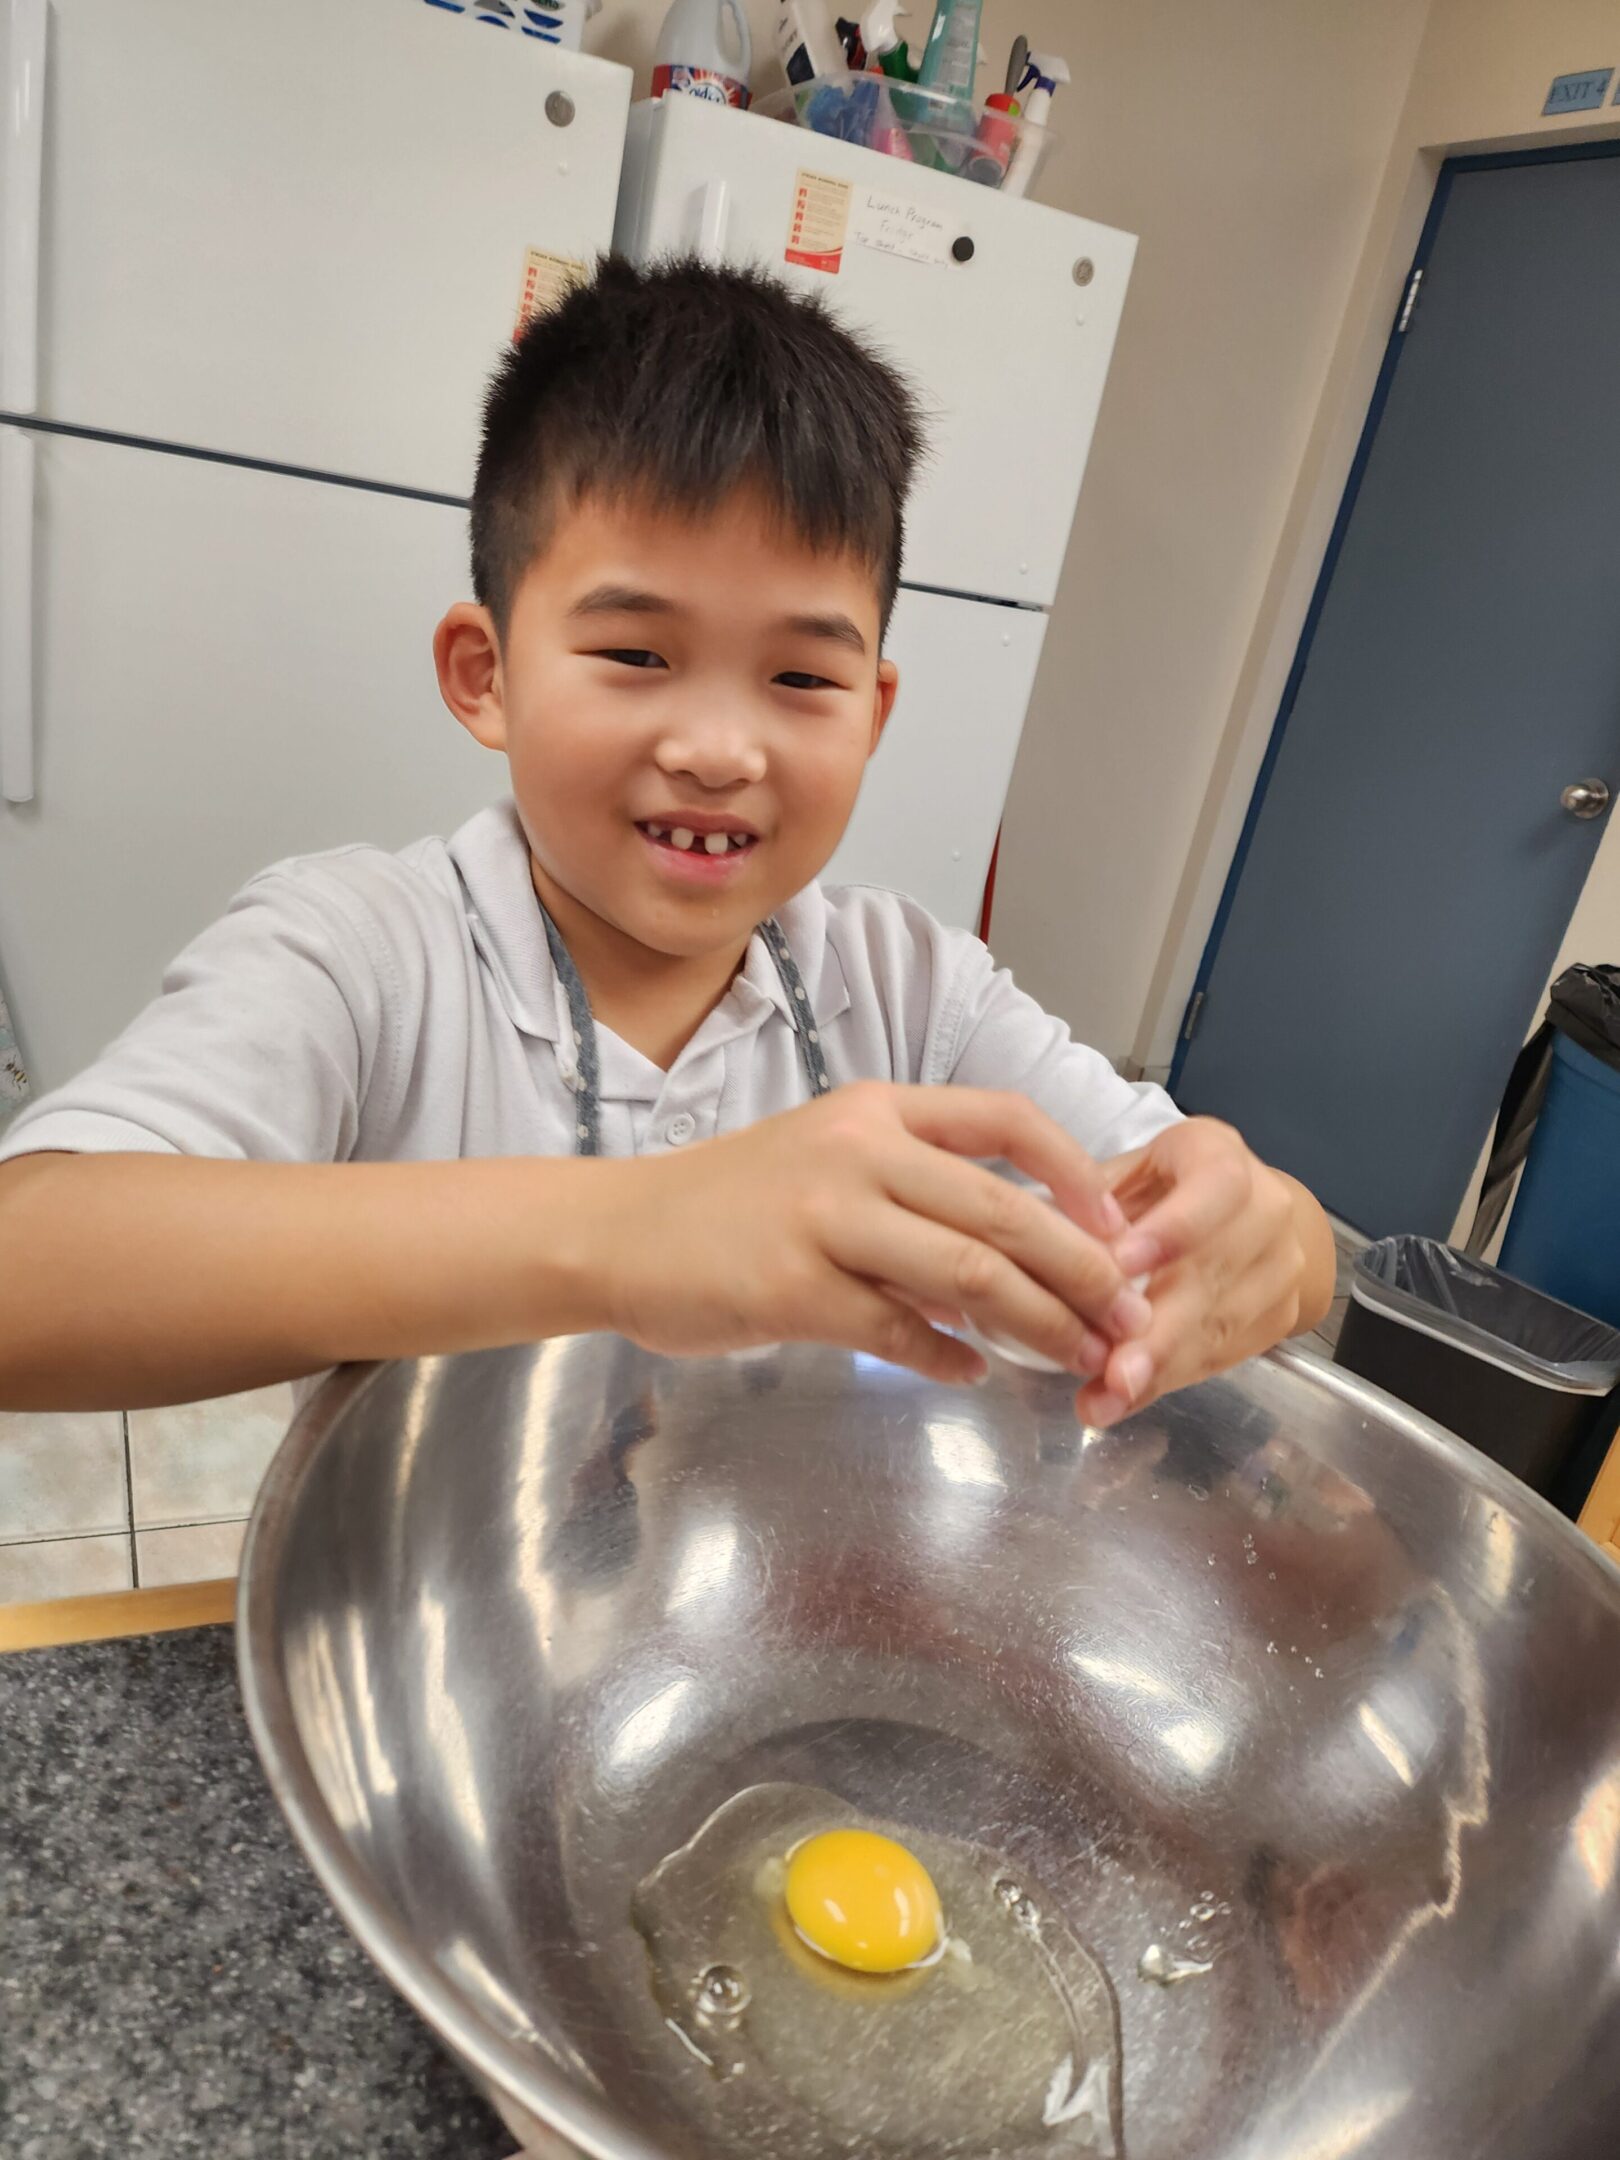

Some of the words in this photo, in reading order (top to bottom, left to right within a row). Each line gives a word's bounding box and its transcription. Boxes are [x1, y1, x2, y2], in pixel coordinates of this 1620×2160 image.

[1549, 81, 1595, 104] EXIT
[866, 195, 901, 217] Lunch
[905, 207, 944, 232] Program
